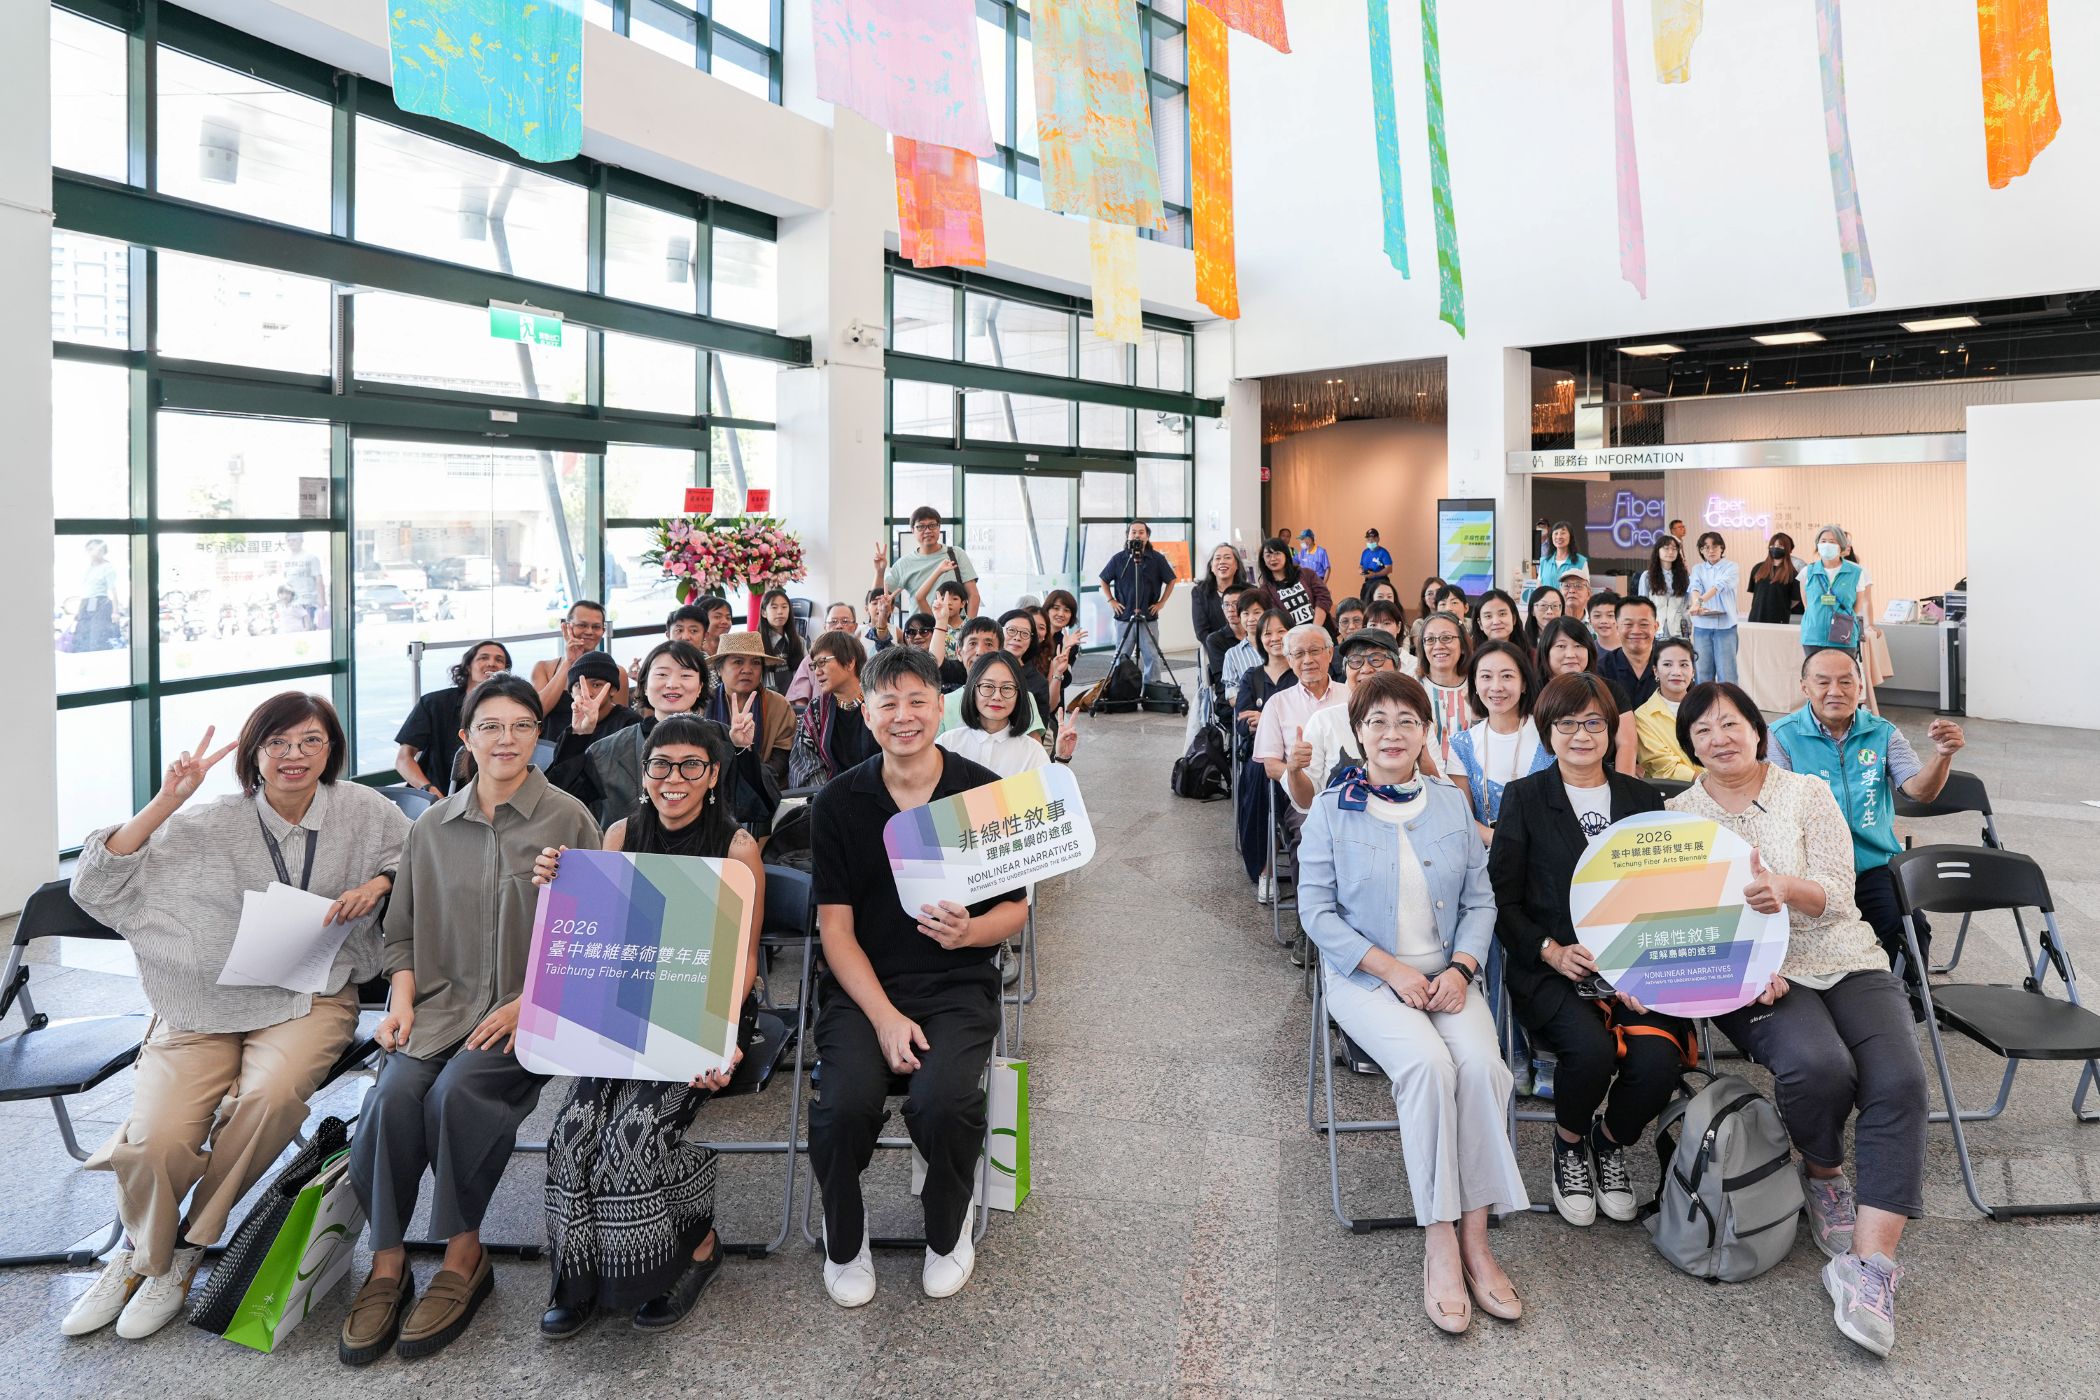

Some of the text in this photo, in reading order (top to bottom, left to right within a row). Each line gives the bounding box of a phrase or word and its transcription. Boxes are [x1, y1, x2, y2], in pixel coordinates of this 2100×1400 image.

[1554, 452, 1684, 467] 服務台 INFORMATION
[1860, 768, 1880, 829] 李天生
[958, 798, 1066, 853] 非線性敘事
[986, 821, 1073, 861] 理解島嶼的途徑
[1636, 831, 1672, 844] 2026
[1611, 841, 1704, 860] 臺中纖維藝術雙年展
[967, 840, 1079, 885] NONLINEAR NARRATIVES
[1613, 858, 1643, 868] Taichung
[1643, 857, 1661, 865] Fiber
[1679, 854, 1707, 862] Biennale
[970, 879, 998, 893] PATHWAYS
[1006, 862, 1049, 882] UNDERSTANDING
[1049, 859, 1060, 867] THE
[1060, 851, 1082, 864] ISLANDS
[551, 919, 598, 936] 2026
[1637, 926, 1721, 948] 非線性敘事
[547, 940, 711, 966] 臺中纖維藝術雙年展
[1648, 945, 1717, 961] 理解島嶼的途徑
[545, 963, 707, 983] Taichung Fiber Arts Biennale
[1644, 965, 1732, 979] NONLINEAR NARRATIVES
